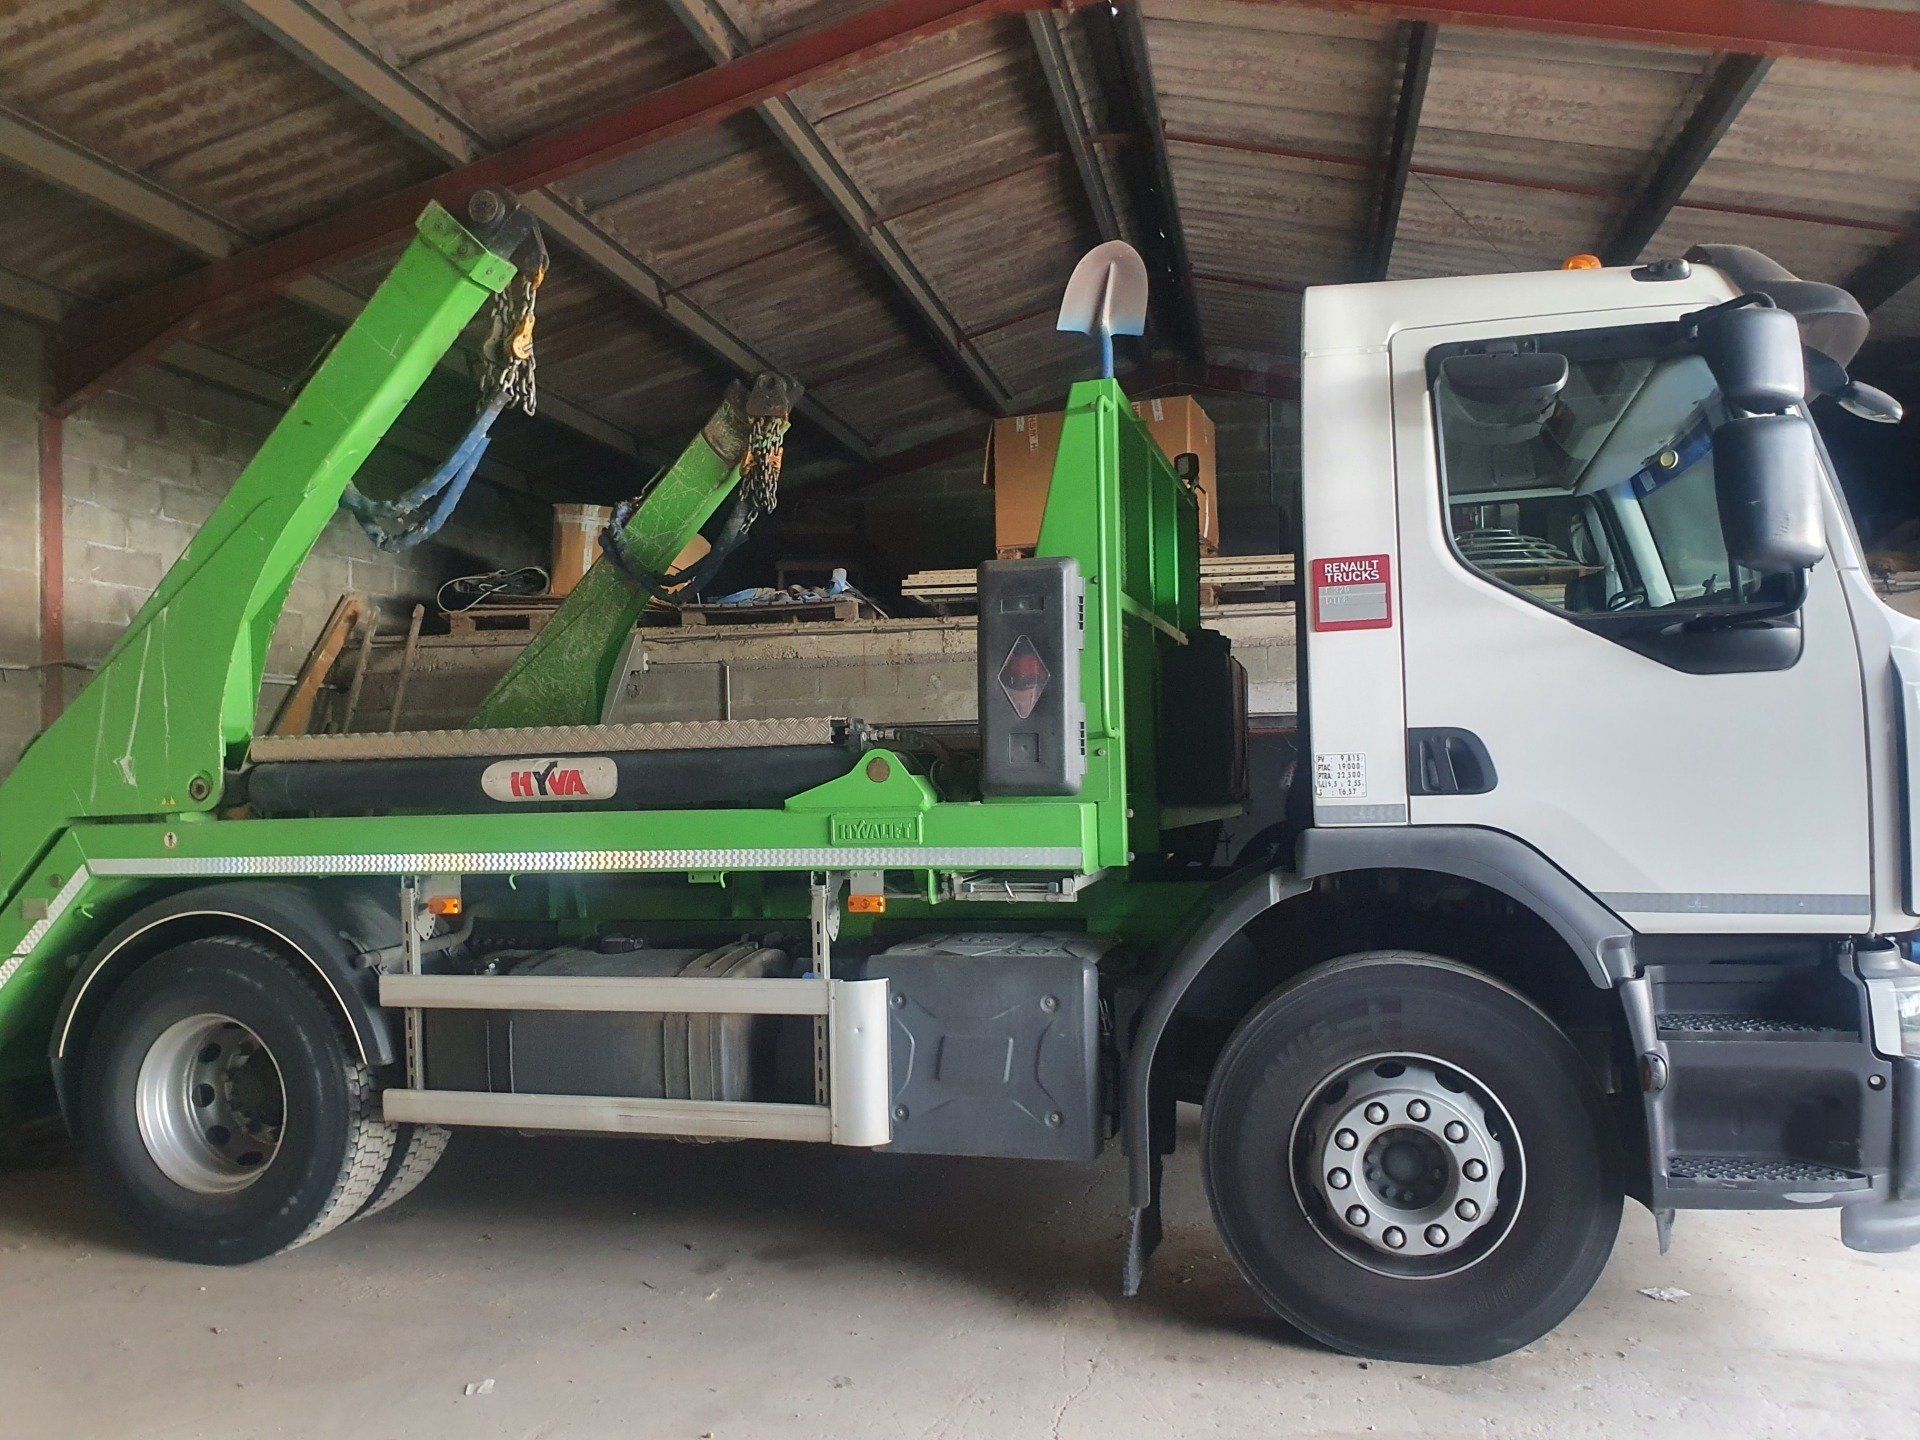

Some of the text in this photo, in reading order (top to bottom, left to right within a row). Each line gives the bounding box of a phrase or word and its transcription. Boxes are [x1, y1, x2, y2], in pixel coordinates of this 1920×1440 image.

[1325, 560, 1379, 573] RENAULT
[1325, 570, 1380, 583] TRUCKS
[510, 762, 589, 796] HYVA
[839, 820, 911, 839] HYVALIFT
